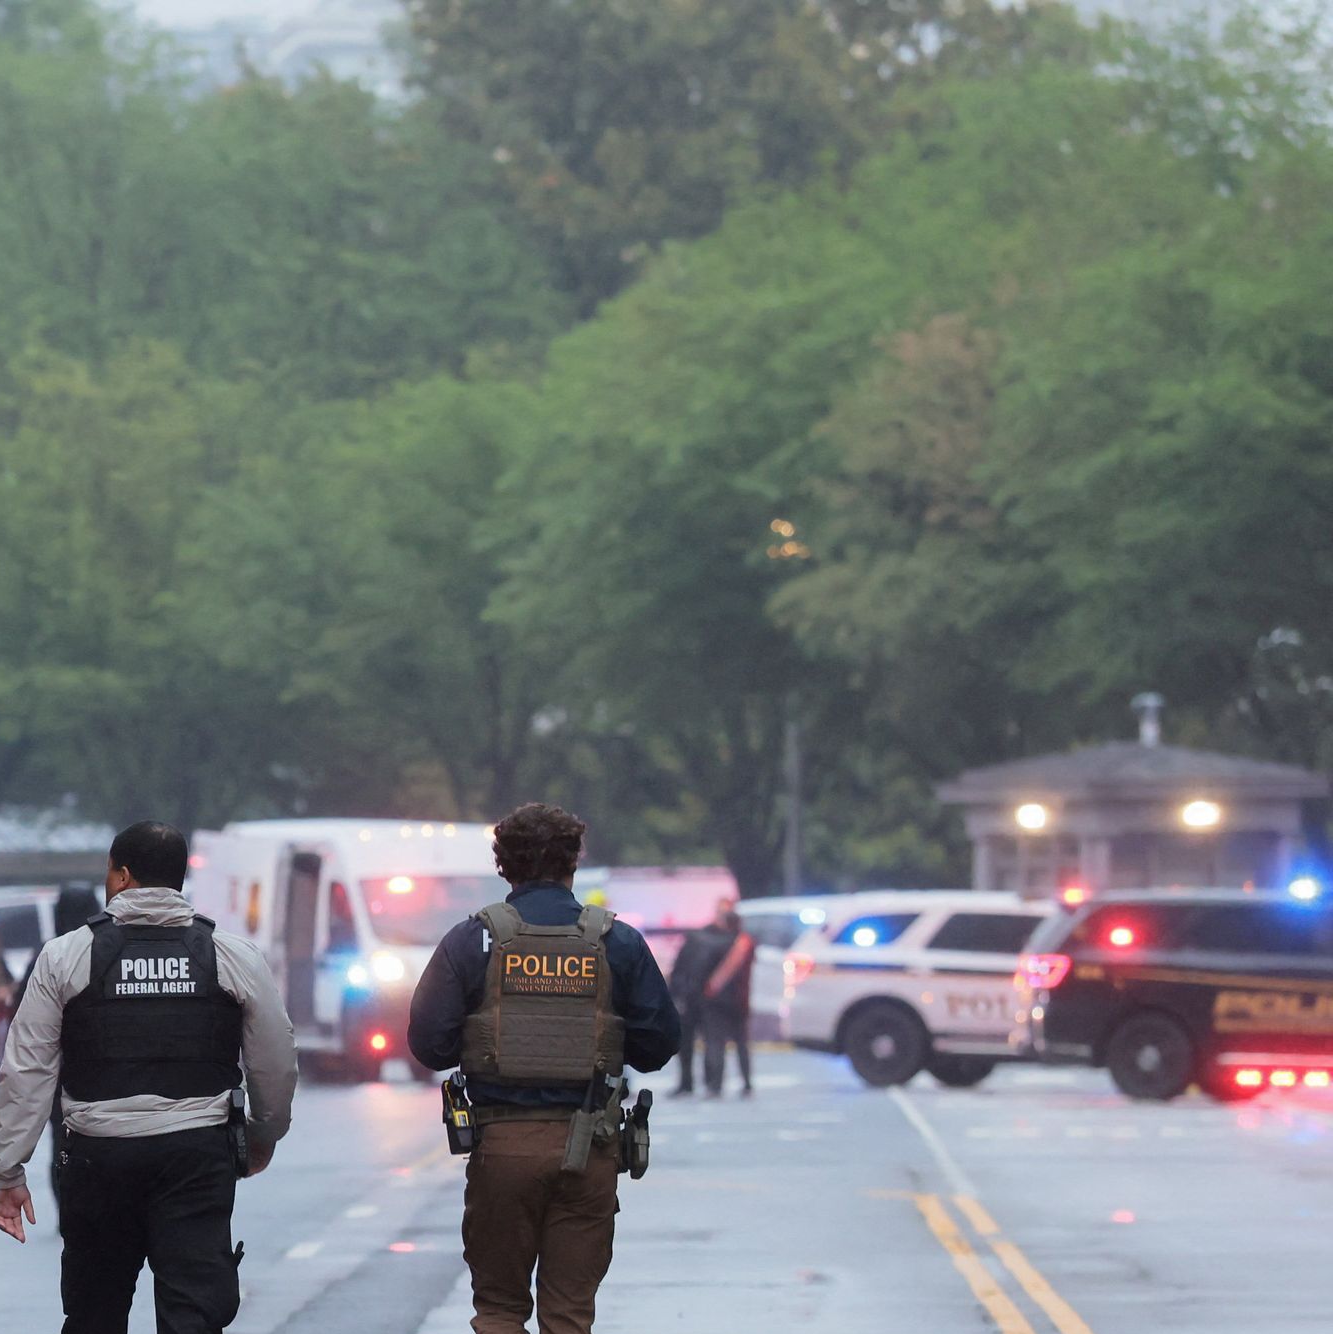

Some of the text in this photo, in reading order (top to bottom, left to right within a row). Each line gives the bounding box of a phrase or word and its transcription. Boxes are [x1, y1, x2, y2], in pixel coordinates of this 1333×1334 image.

[121, 957, 190, 980] POLICE
[506, 955, 595, 977] POLICE
[116, 982, 196, 994] FEDERAL AGENT
